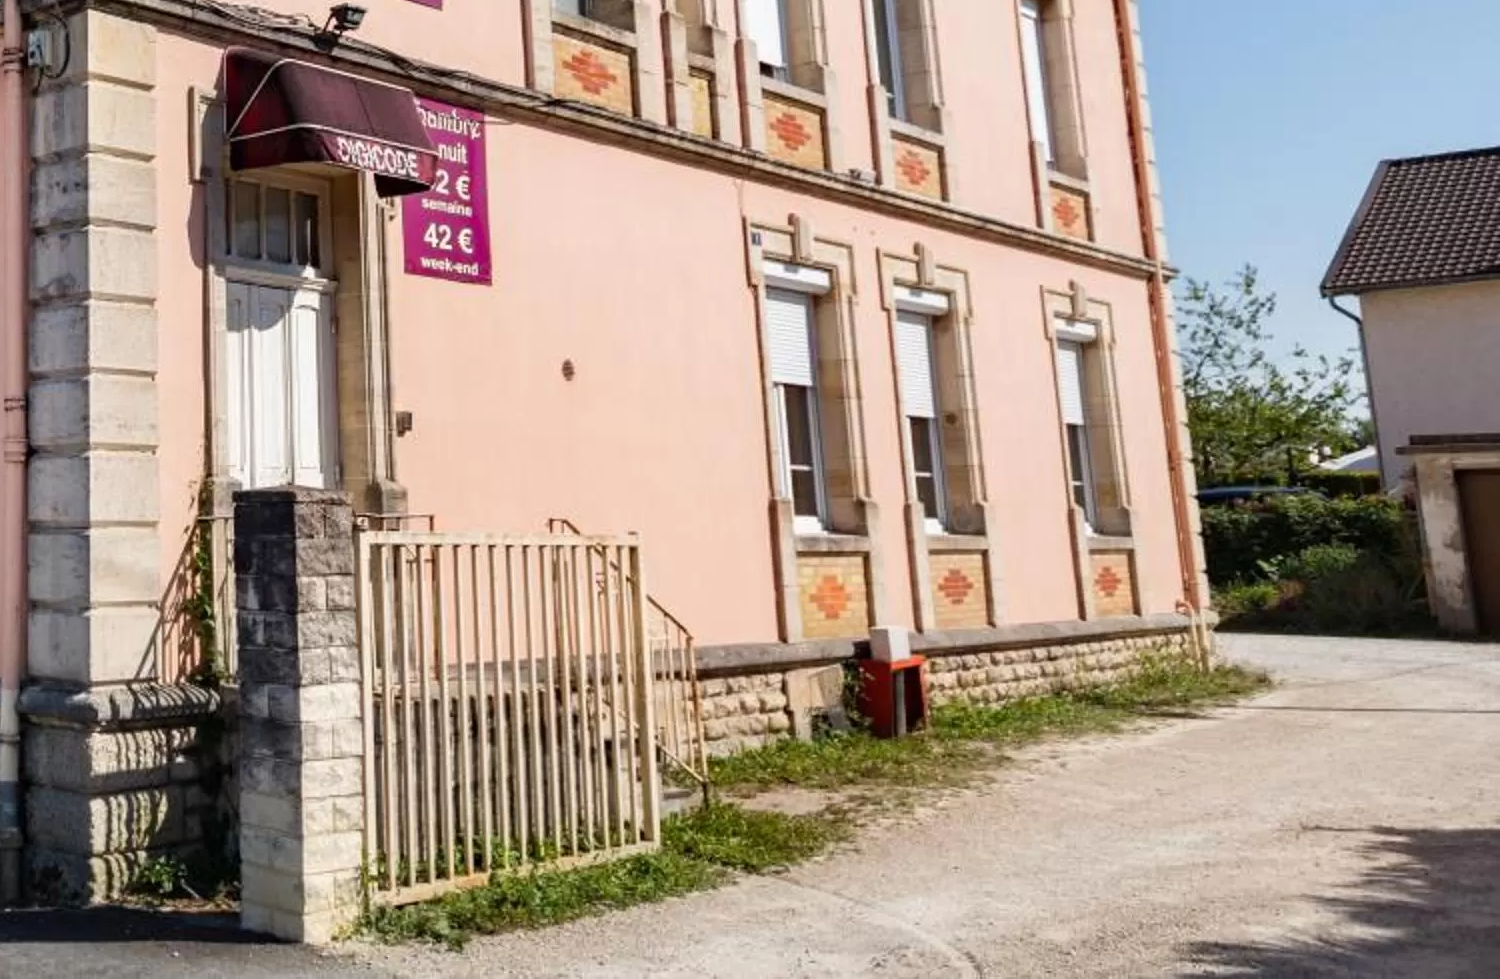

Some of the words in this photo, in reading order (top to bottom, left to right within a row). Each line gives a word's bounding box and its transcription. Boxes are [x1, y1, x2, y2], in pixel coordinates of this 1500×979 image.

[336, 136, 420, 178] DIGICODE
[438, 142, 468, 165] nuit
[430, 168, 450, 195] 2
[455, 174, 471, 200] €
[421, 198, 473, 218] semaine
[423, 222, 453, 250] 42
[457, 227, 473, 254] €
[420, 257, 479, 276] week-end
